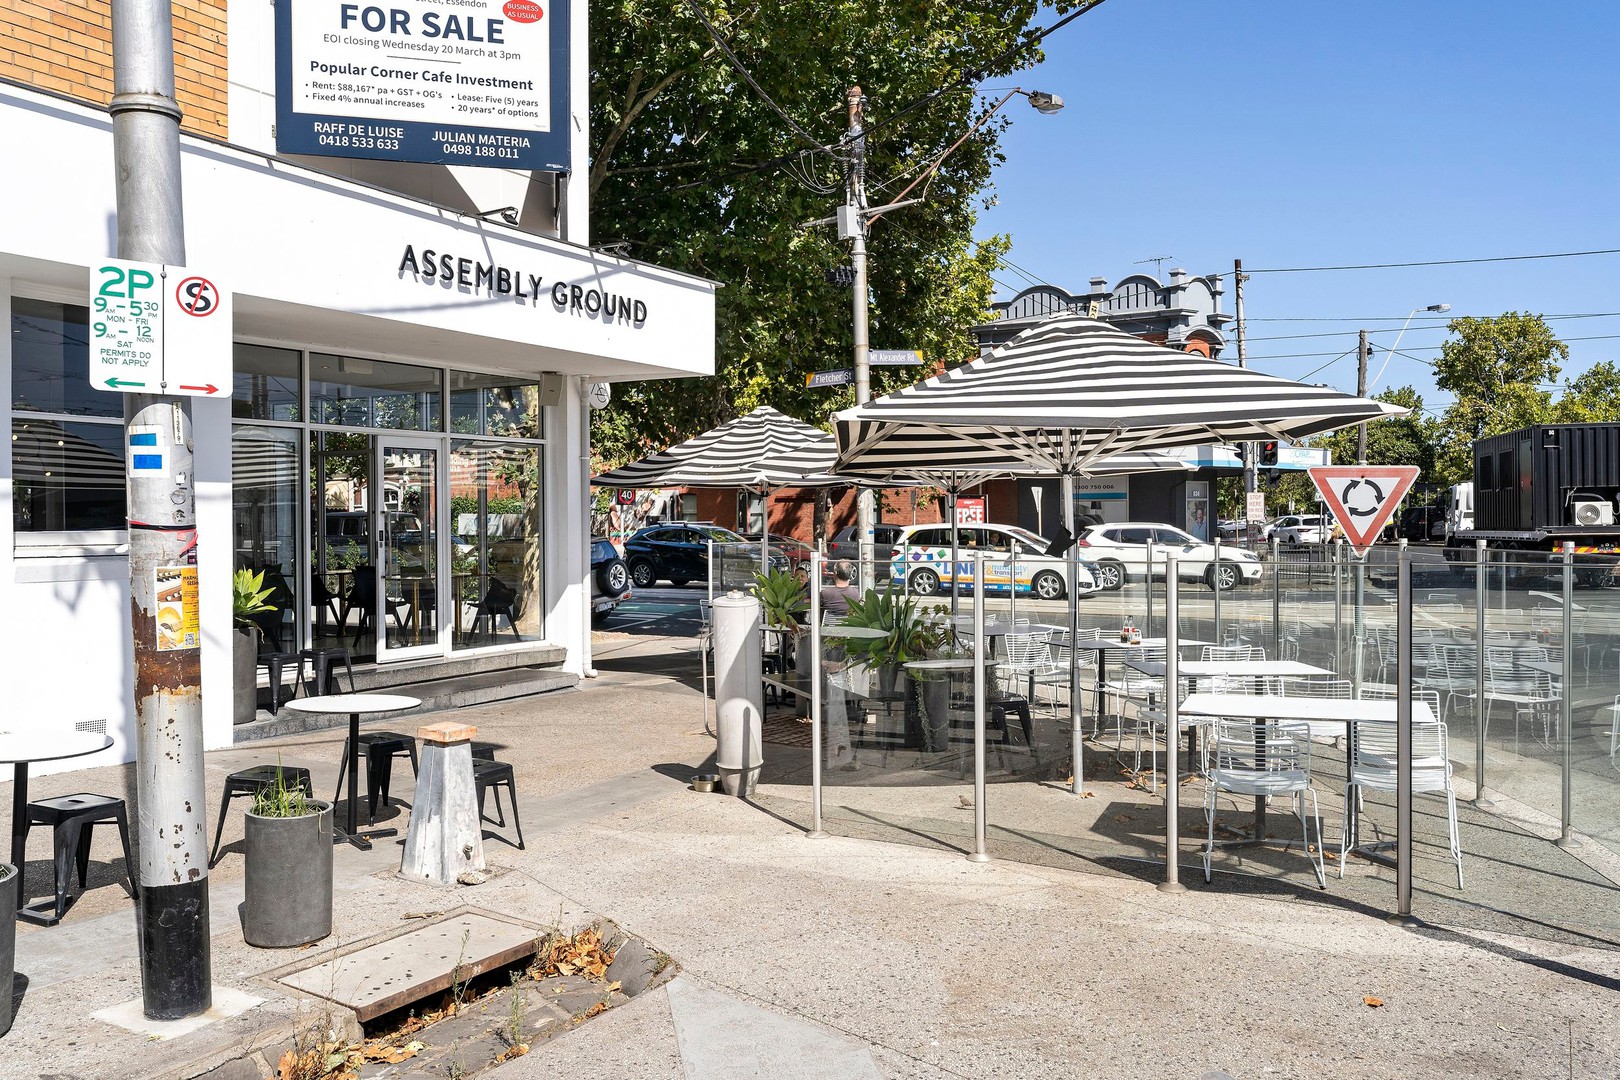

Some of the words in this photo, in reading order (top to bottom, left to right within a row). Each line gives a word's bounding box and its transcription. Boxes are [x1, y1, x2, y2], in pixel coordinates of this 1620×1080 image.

[507, 3, 538, 12] BUSINESS
[517, 12, 538, 20] USUAL
[341, 4, 411, 36] FOR
[422, 12, 504, 44] SALE
[324, 34, 341, 44] EOI
[344, 36, 380, 50] closing
[382, 39, 440, 54] Wednesday
[442, 45, 454, 54] 20
[456, 46, 486, 56] March
[500, 50, 521, 60] 3pm
[310, 60, 367, 76] Popular
[370, 66, 418, 80] Corner
[422, 70, 452, 84] Cafe
[456, 74, 534, 90] Investment
[312, 81, 336, 90] Rent:
[396, 88, 414, 96] GST
[422, 90, 442, 99] OG's
[312, 93, 336, 102] Fixed
[338, 95, 352, 103] 4%
[354, 96, 383, 106] annual
[385, 98, 425, 109] increases
[458, 94, 484, 102] Lease:
[486, 96, 502, 104] Five
[504, 97, 514, 106] (5)
[498, 108, 506, 116] of
[508, 110, 538, 118] options
[314, 122, 346, 134] RAFF
[348, 125, 365, 136] DE
[368, 126, 404, 138] LUISE
[320, 134, 348, 146] 0418
[352, 137, 374, 148] 533
[376, 139, 399, 150] 633
[432, 131, 476, 144] JULIAN
[478, 134, 531, 148] MATERIA
[443, 144, 472, 155] 0498
[474, 146, 496, 157] 188
[498, 148, 520, 159] 011
[98, 266, 154, 298] 2P
[399, 244, 542, 301] ASSEMBLY
[551, 281, 648, 324] GROUND
[106, 314, 126, 323] MON
[136, 326, 152, 338] 12
[117, 340, 133, 348] SAT
[100, 348, 136, 358] PERMITS
[140, 351, 152, 359] DO
[870, 353, 878, 362] Mt
[879, 352, 906, 362] Alexander
[907, 352, 914, 362] Rd
[102, 357, 118, 365] NOT
[122, 358, 150, 368] APPLY
[816, 373, 842, 384] Fletcher
[844, 371, 852, 381] St
[622, 490, 632, 500] 40
